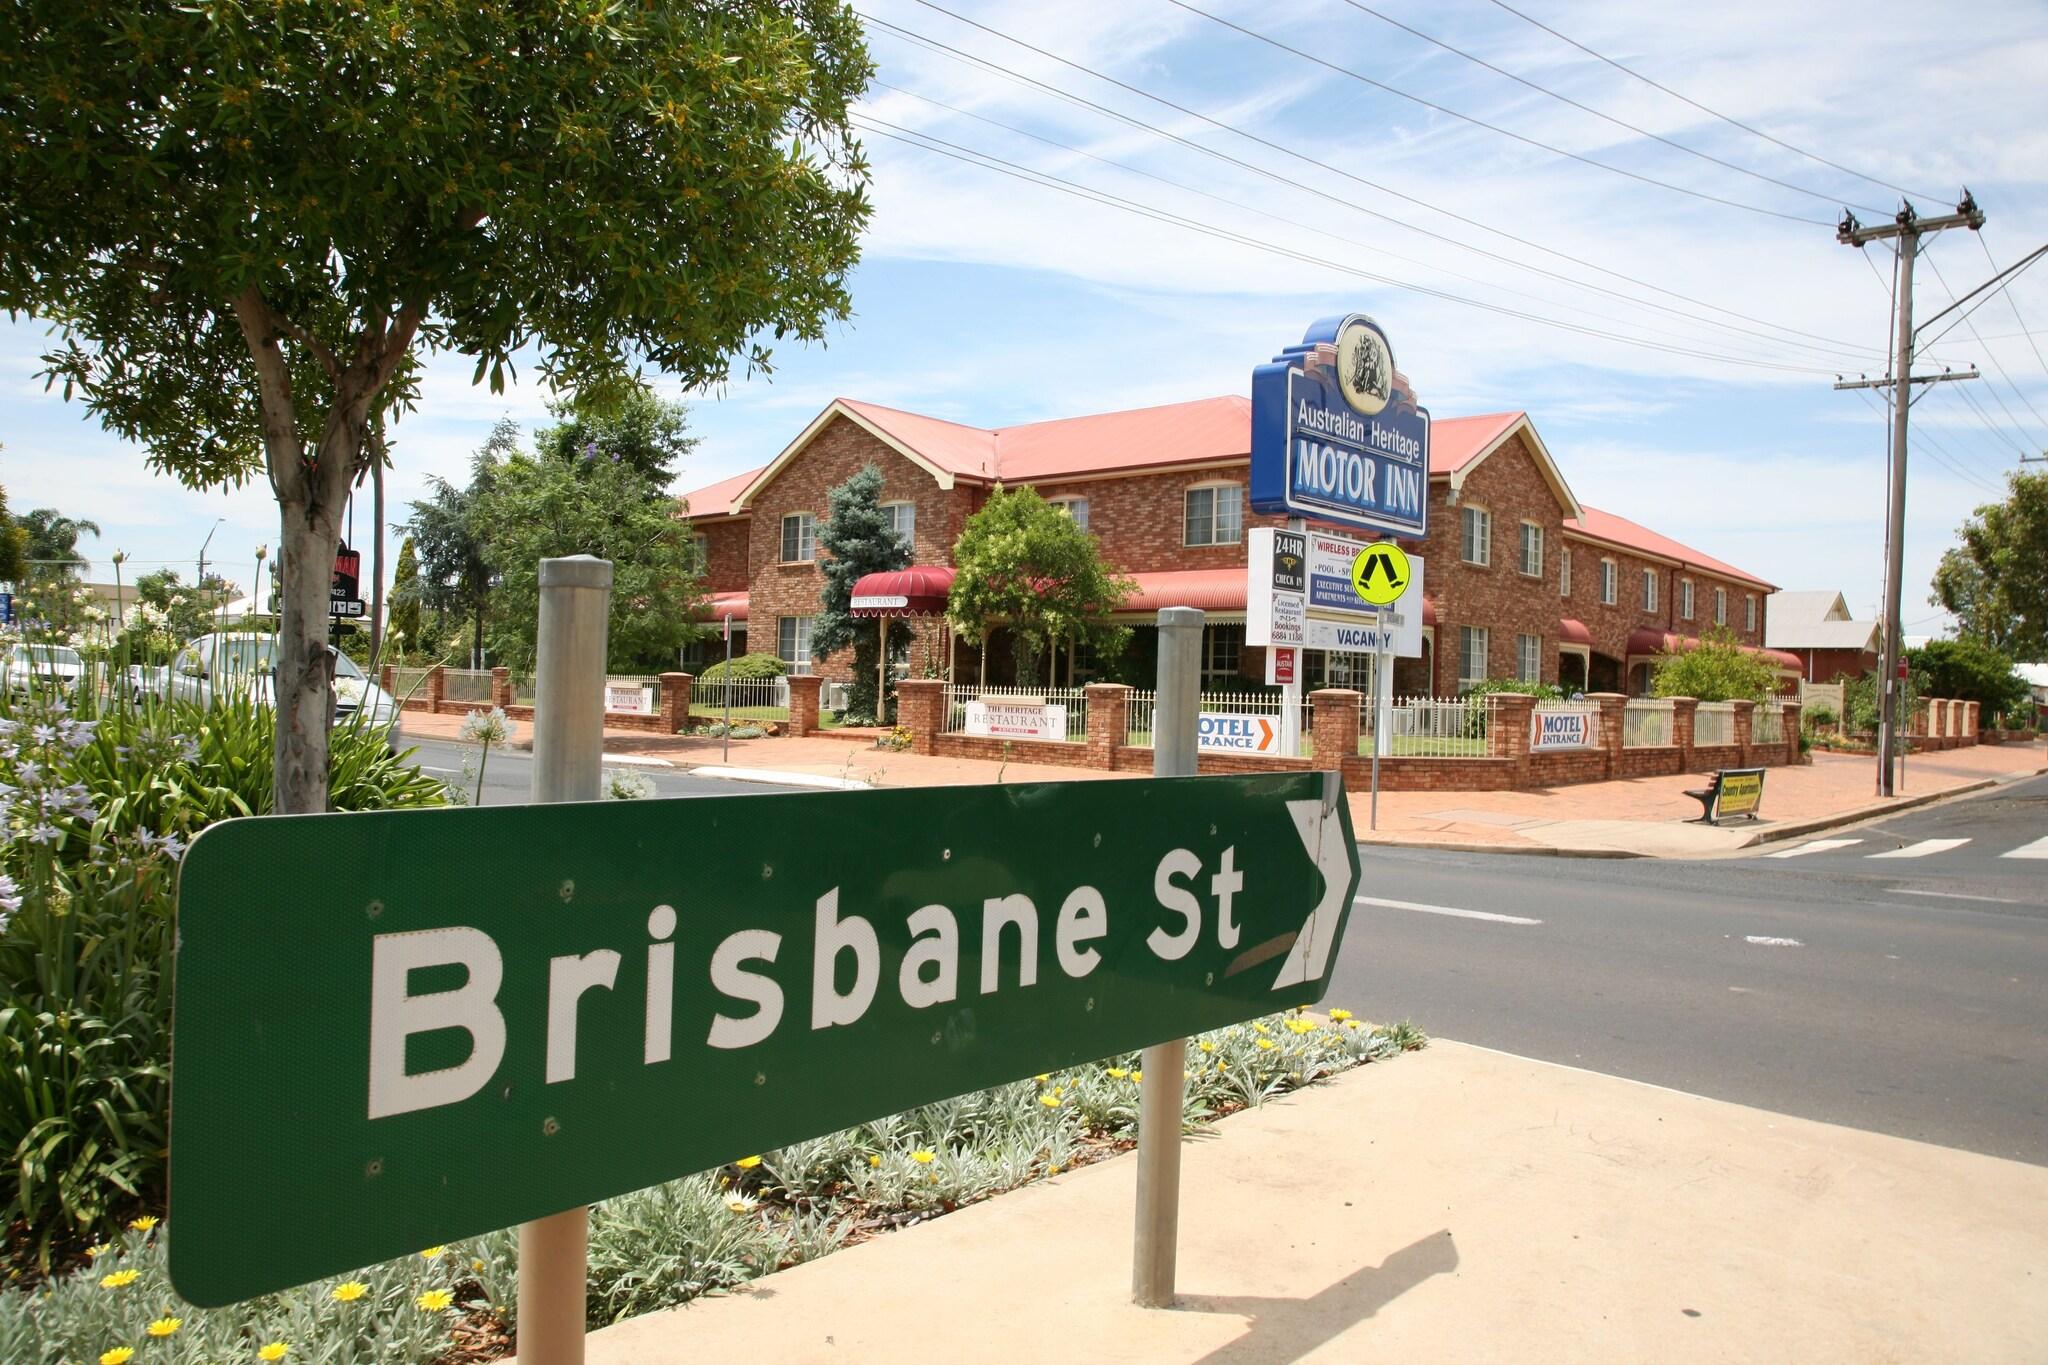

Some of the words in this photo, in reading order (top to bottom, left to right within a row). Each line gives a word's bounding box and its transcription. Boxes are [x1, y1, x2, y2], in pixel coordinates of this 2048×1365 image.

[1298, 398, 1364, 443] Australian
[1371, 421, 1420, 463] Heritage
[1296, 439, 1376, 504] MOTOR
[1385, 463, 1420, 514] INN
[1275, 536, 1304, 559] 24HR
[1317, 541, 1350, 556] WIRELESS
[1318, 563, 1335, 574] POOL
[1275, 573, 1294, 586] CHECK
[1296, 576, 1304, 587] IN
[1316, 579, 1343, 592] EXECUTIVE
[853, 597, 897, 606] RESTAURANT
[1277, 599, 1300, 609] Licensed
[1316, 591, 1346, 603] APARTMENTS
[1274, 621, 1301, 632] Bookings
[1337, 628, 1391, 648] VACANY
[988, 705, 1001, 713] THE
[1004, 705, 1043, 715] HERITAGE
[974, 713, 1057, 728] RESTAURANT
[1198, 717, 1255, 737] OTEL
[1543, 716, 1581, 733] MOTEL
[1543, 734, 1580, 745] ENTRANCE
[367, 886, 1107, 1120] Brisbane
[1146, 845, 1244, 961] St
